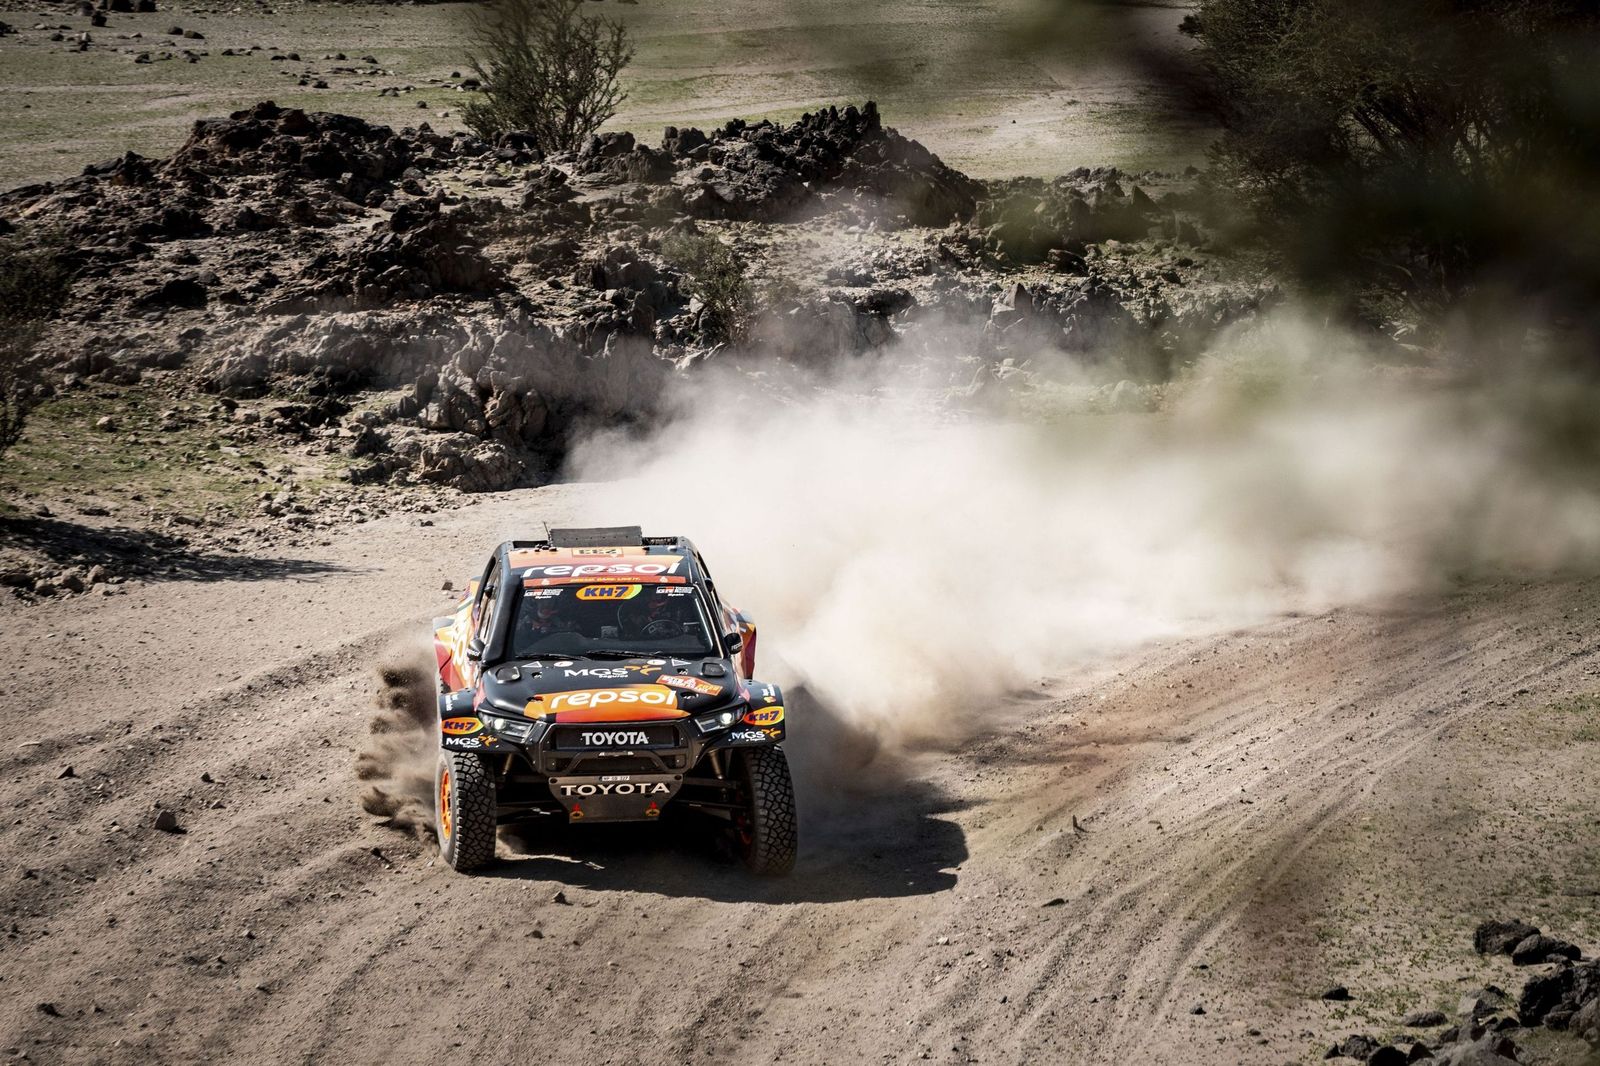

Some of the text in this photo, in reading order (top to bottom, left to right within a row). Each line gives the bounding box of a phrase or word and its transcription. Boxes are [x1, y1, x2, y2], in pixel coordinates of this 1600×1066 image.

[522, 563, 680, 577] repsol
[564, 668, 628, 677] MGS
[550, 690, 676, 708] repsol
[445, 737, 481, 746] MGS
[581, 731, 649, 746] TOYOTA
[731, 731, 766, 740] MGS
[560, 782, 670, 796] TOYOTA
